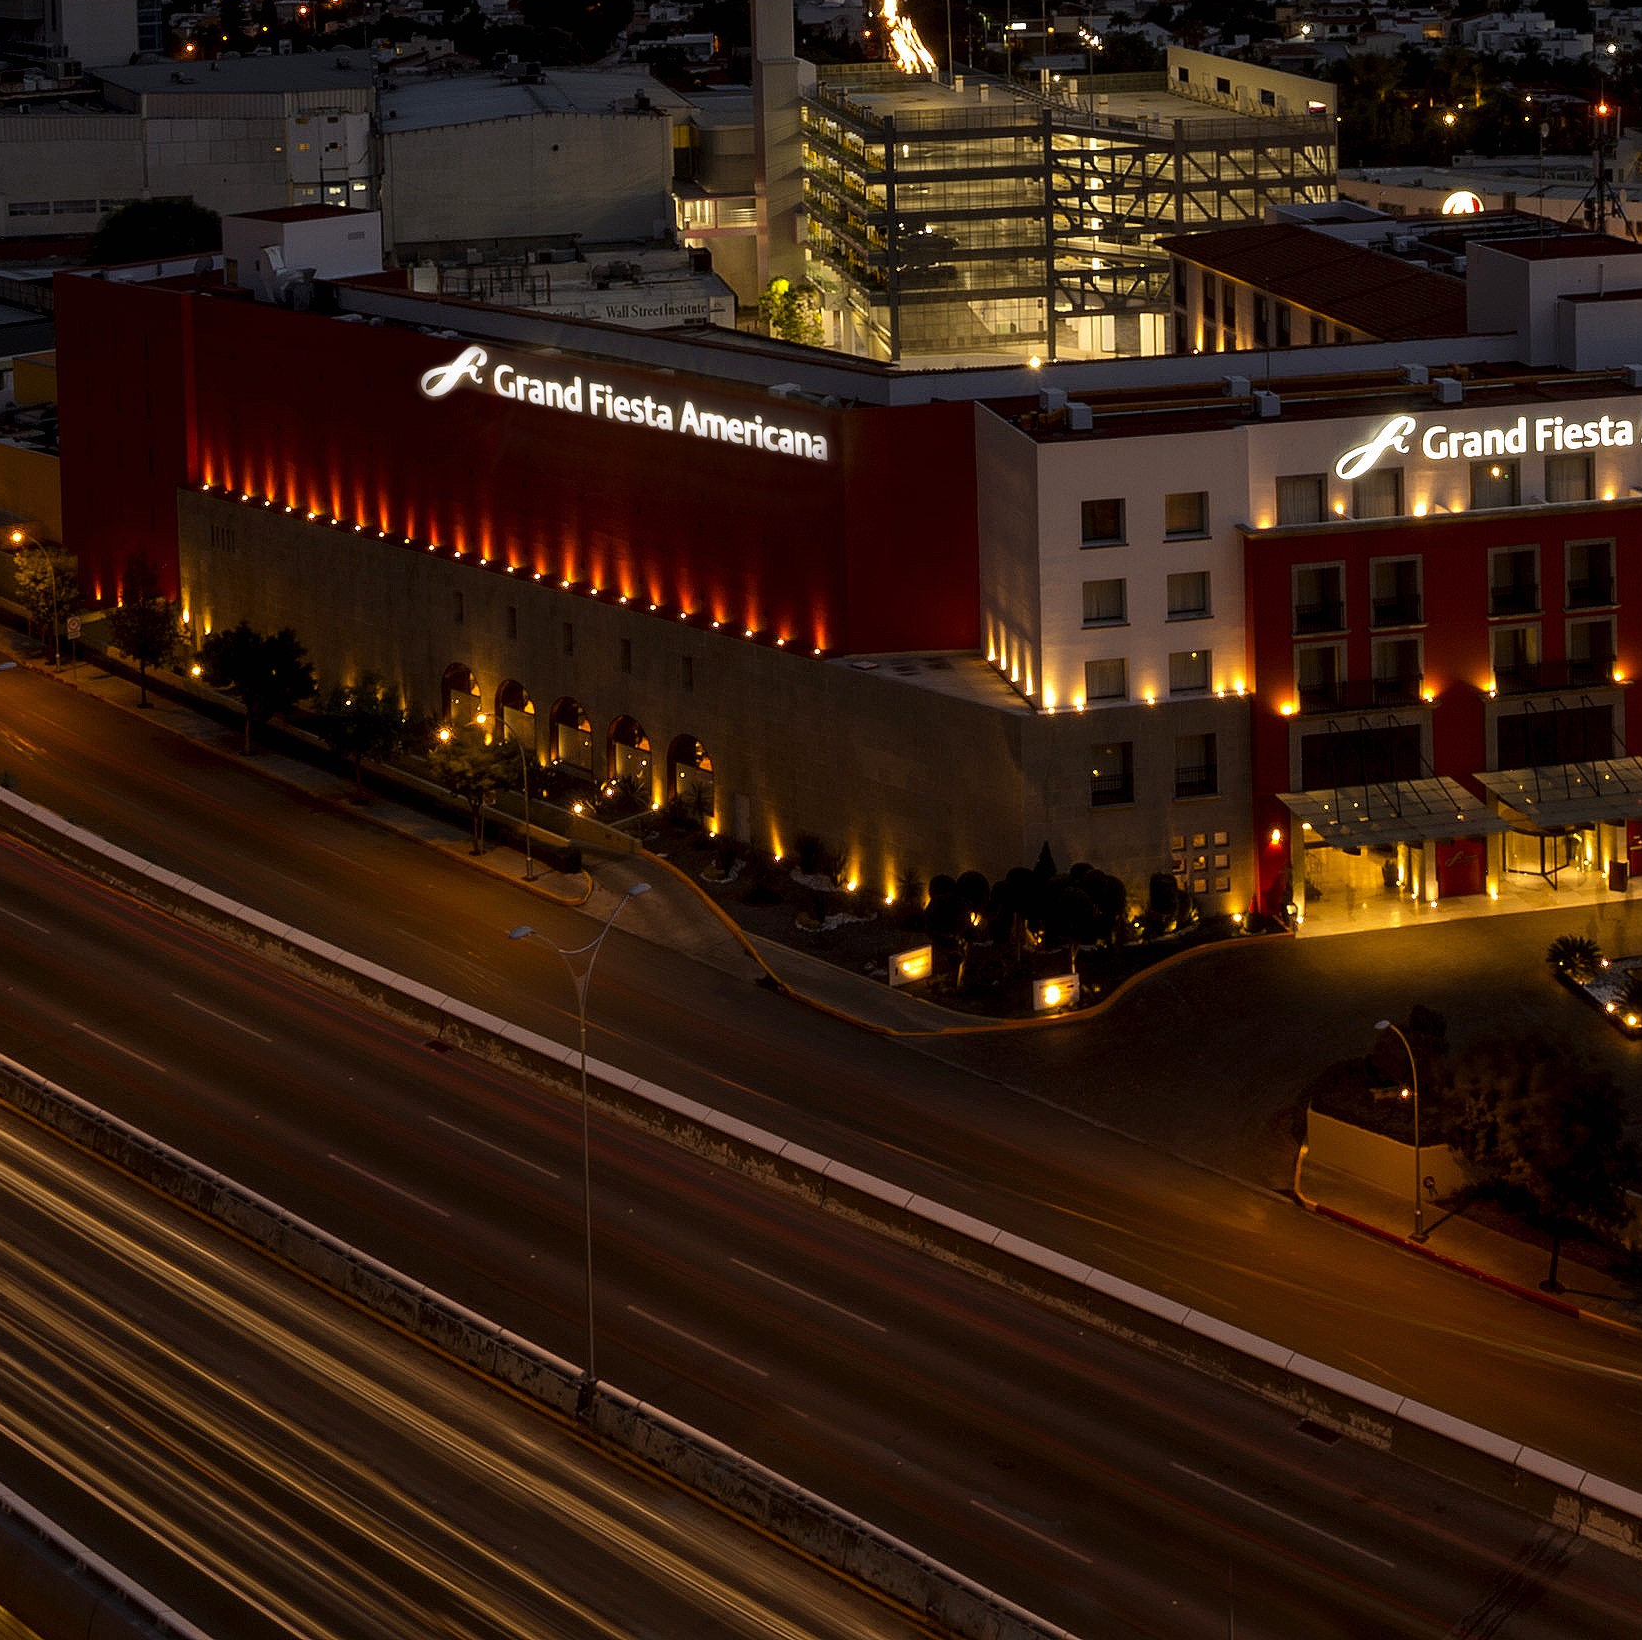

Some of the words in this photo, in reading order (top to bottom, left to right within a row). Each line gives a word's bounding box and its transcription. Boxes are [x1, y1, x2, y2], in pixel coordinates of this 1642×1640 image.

[606, 305, 630, 319] Wall
[631, 304, 664, 317] Street
[664, 302, 708, 315] Institute
[494, 364, 583, 413] Grand
[589, 383, 674, 431] Fiesta
[680, 401, 829, 462] Americana
[1422, 416, 1527, 461] Grand
[1535, 415, 1634, 452] Fiesta
